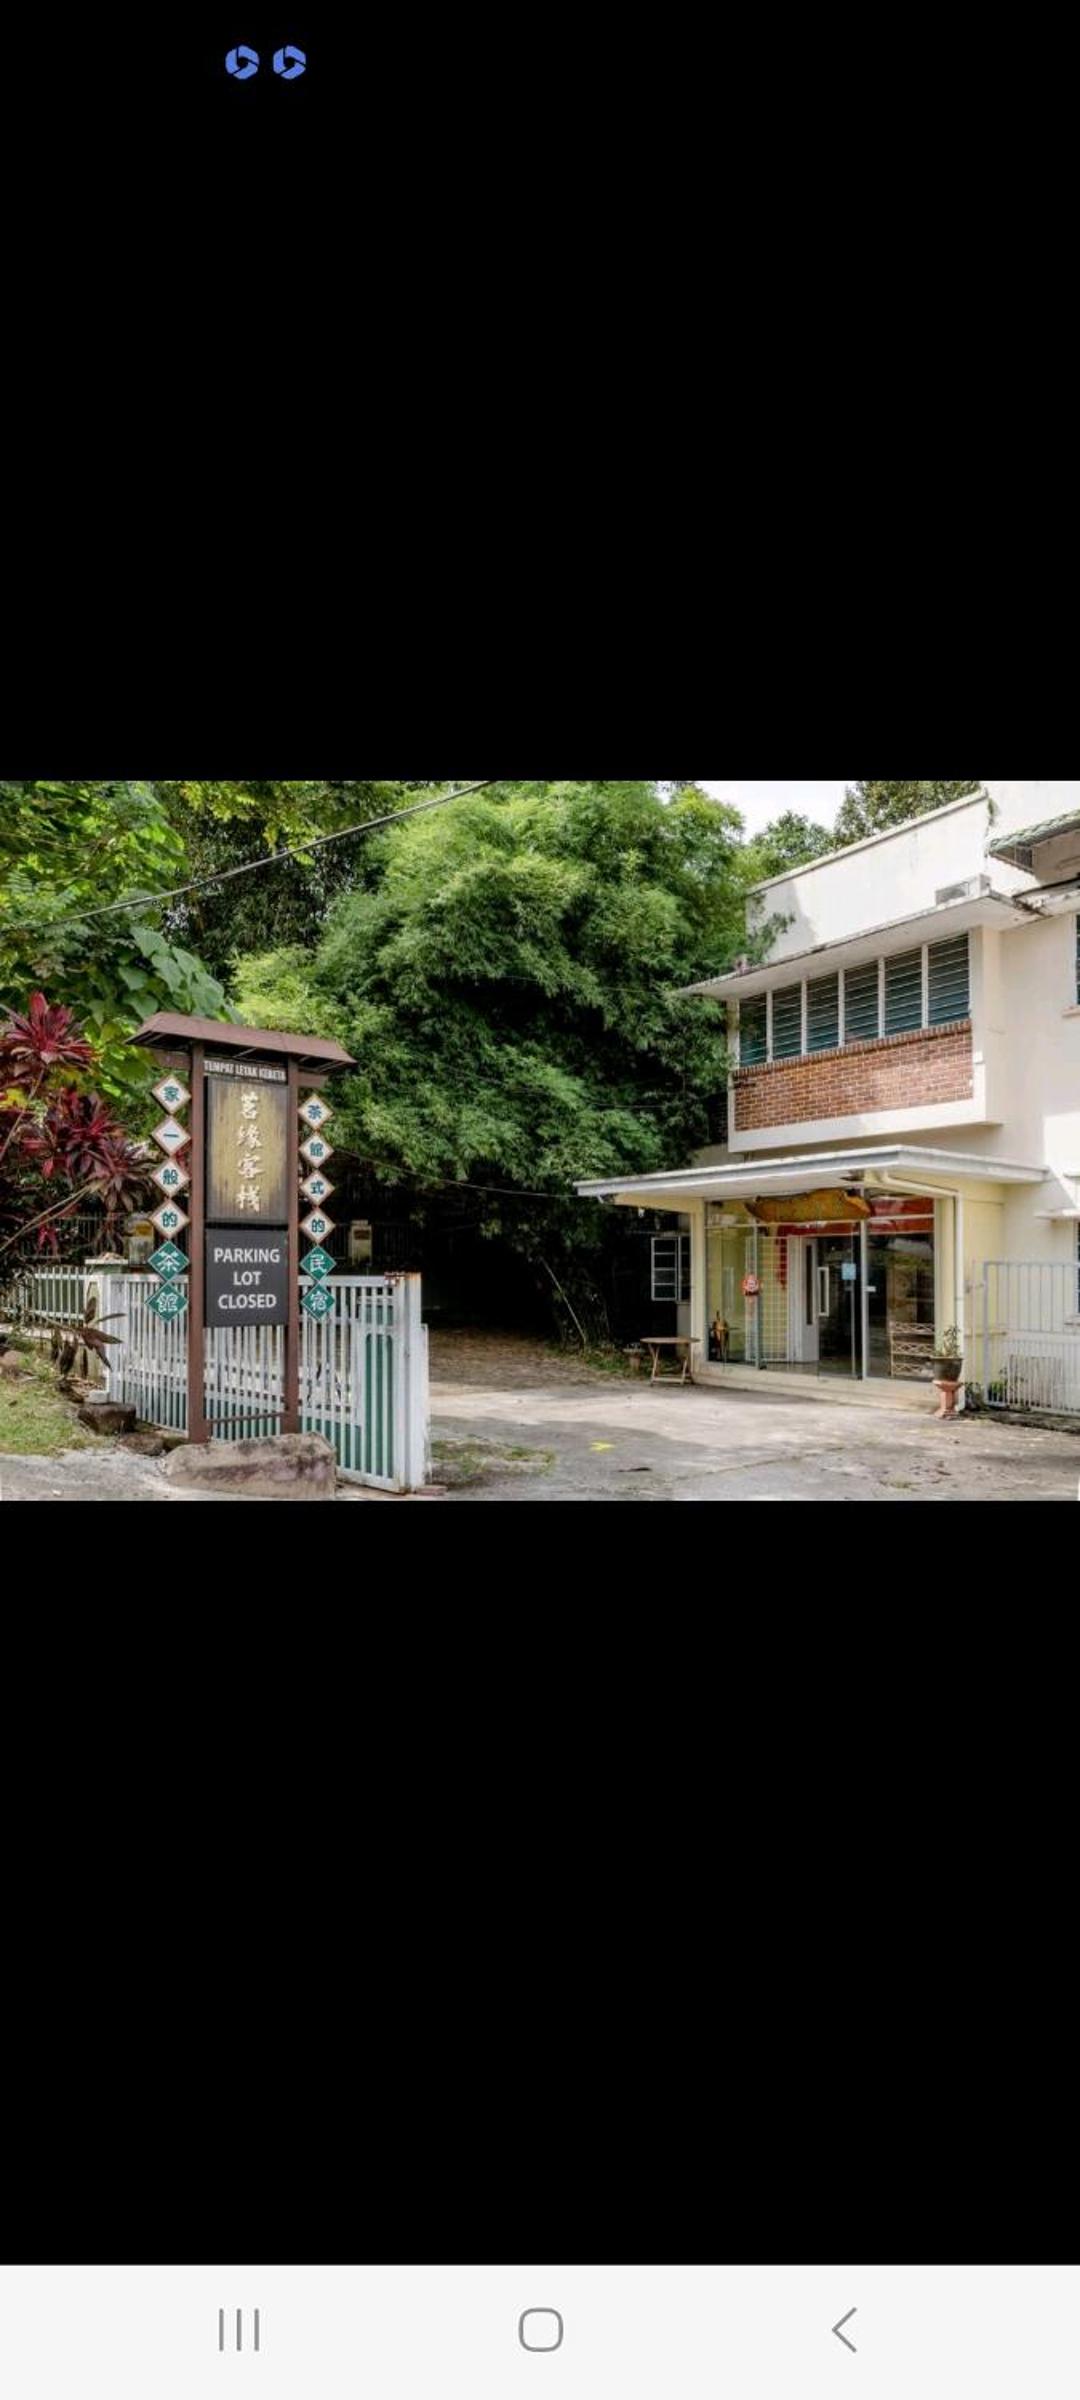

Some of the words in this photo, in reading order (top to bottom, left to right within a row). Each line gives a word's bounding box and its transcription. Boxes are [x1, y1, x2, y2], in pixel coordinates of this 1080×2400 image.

[214, 1247, 281, 1264] PARKING
[233, 1271, 262, 1286] LOT
[218, 1293, 278, 1309] CLOSED
